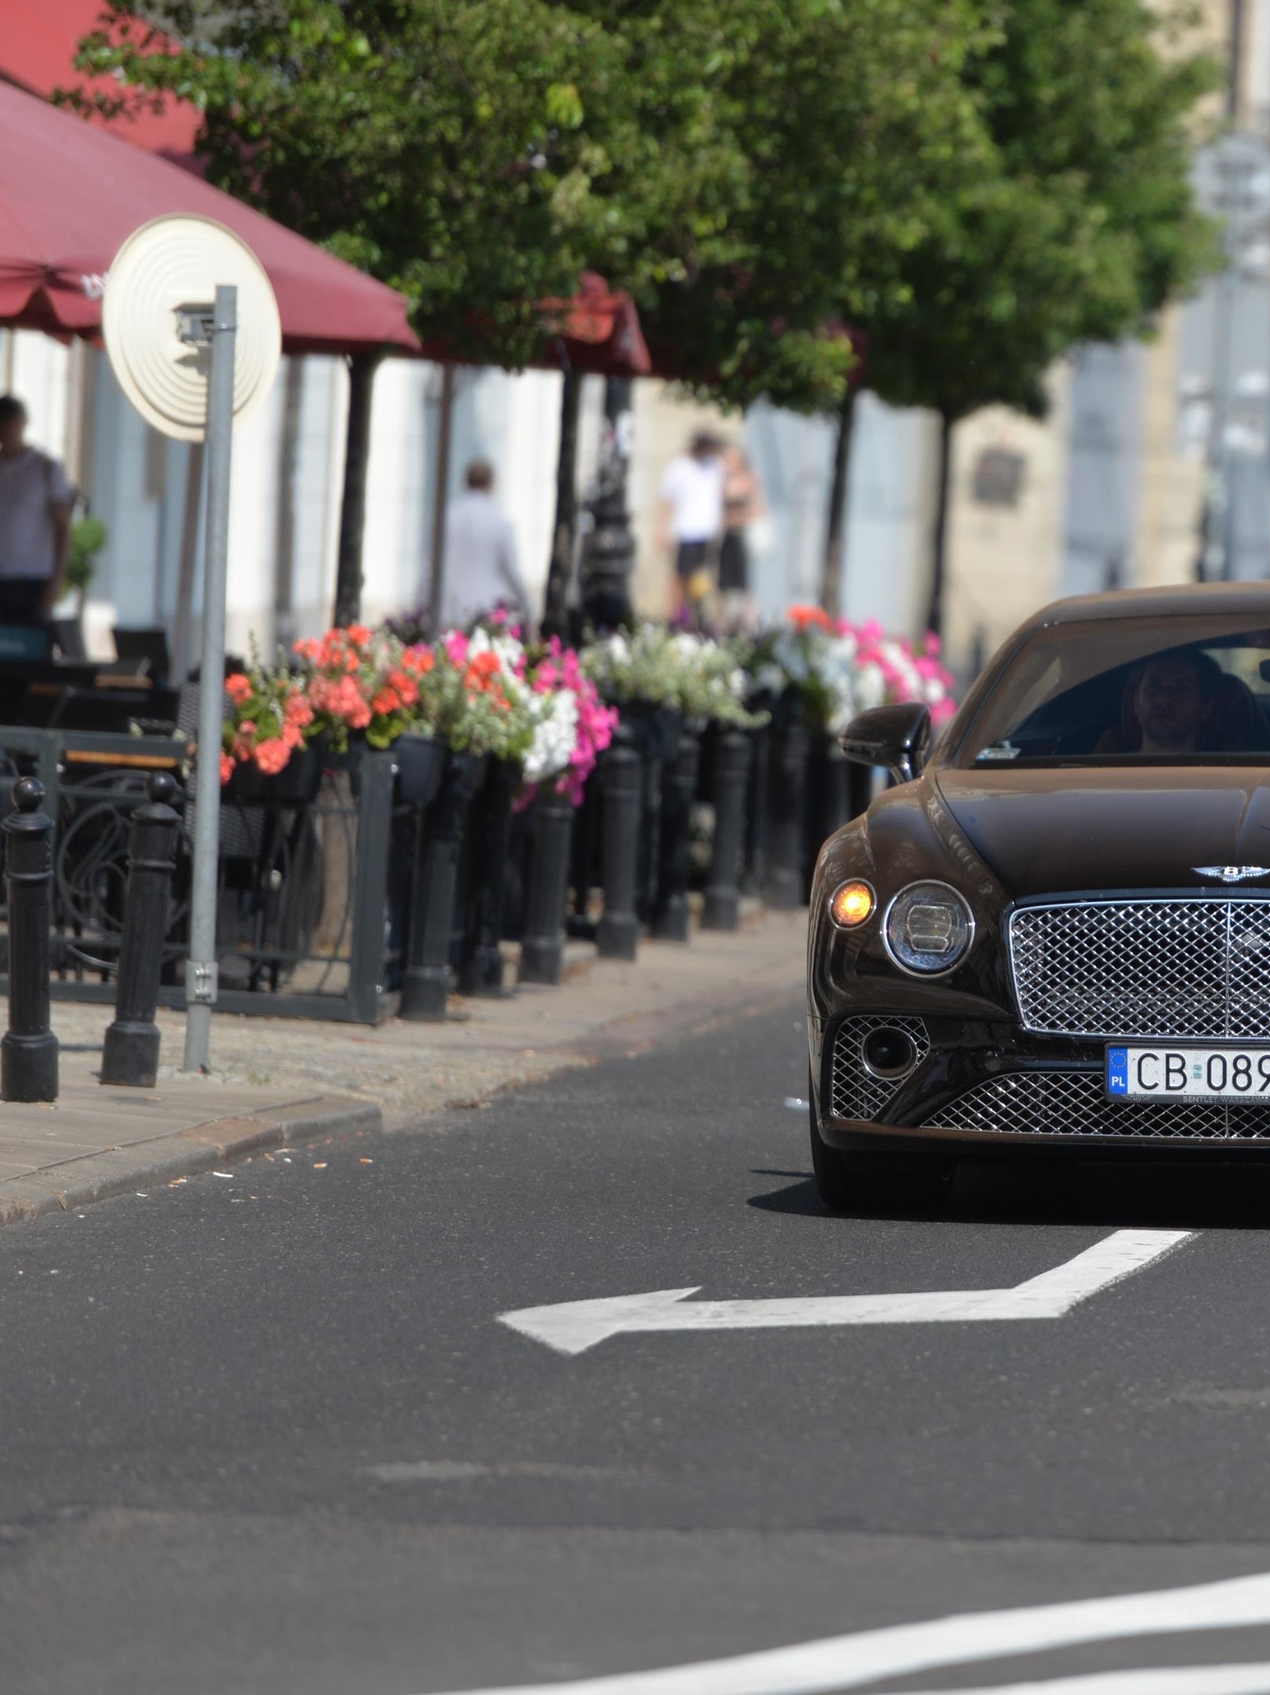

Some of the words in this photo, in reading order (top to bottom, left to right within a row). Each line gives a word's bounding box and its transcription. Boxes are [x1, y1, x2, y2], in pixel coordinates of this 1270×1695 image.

[1223, 866, 1239, 876] B
[1137, 1053, 1187, 1091] CB
[1111, 1076, 1126, 1087] PL
[1182, 1095, 1219, 1104] BENTLEY
